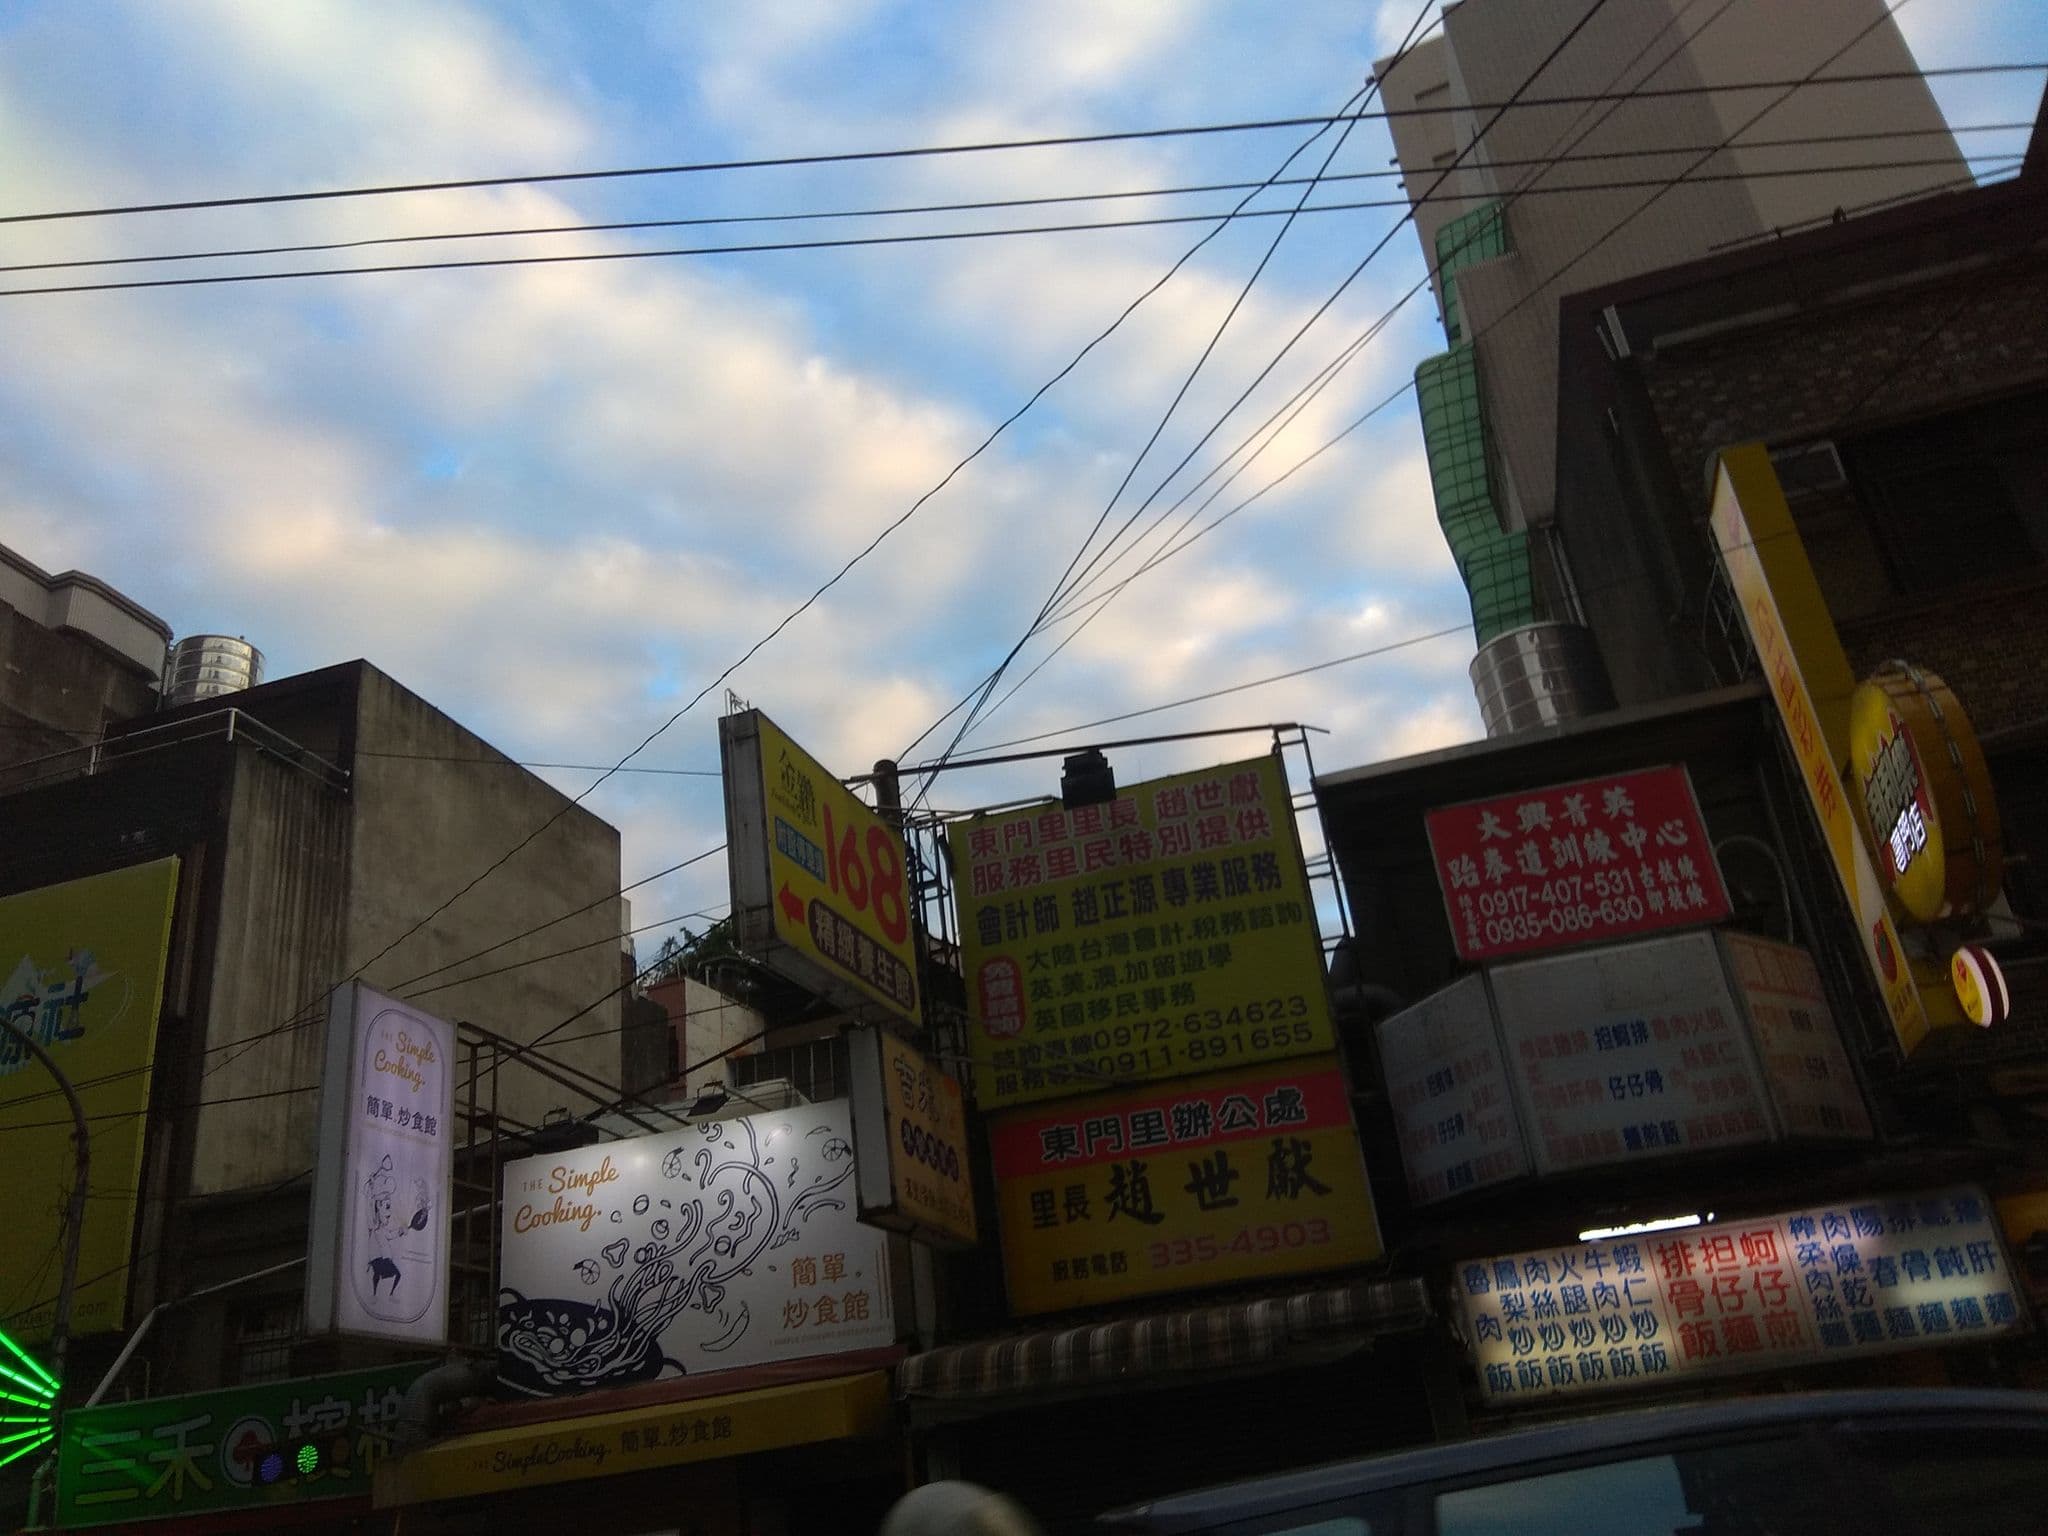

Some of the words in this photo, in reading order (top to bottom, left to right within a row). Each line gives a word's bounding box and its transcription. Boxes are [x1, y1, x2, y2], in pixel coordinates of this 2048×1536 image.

[968, 798, 1139, 860] 東門里里長
[972, 808, 1271, 897] 服務里民特別提供
[1447, 818, 1688, 889] 跆拳道訓練中心
[824, 802, 907, 945] 168
[977, 896, 1061, 947] 會計師
[1073, 851, 1282, 928] 趙正源專業服務
[1478, 867, 1635, 917] 0917-407-531
[1485, 896, 1644, 944] 0935-086-630
[1033, 982, 1195, 1032] 英國移民事務
[396, 1031, 435, 1064] Simple
[1039, 1085, 1307, 1162] 東門里辦公處
[549, 1156, 619, 1194] Simple
[1030, 1183, 1091, 1230] 里長
[1149, 1217, 1334, 1271] 335-4903
[782, 1290, 870, 1329] 炒食館
[1656, 1240, 1721, 1360] 排骨飯
